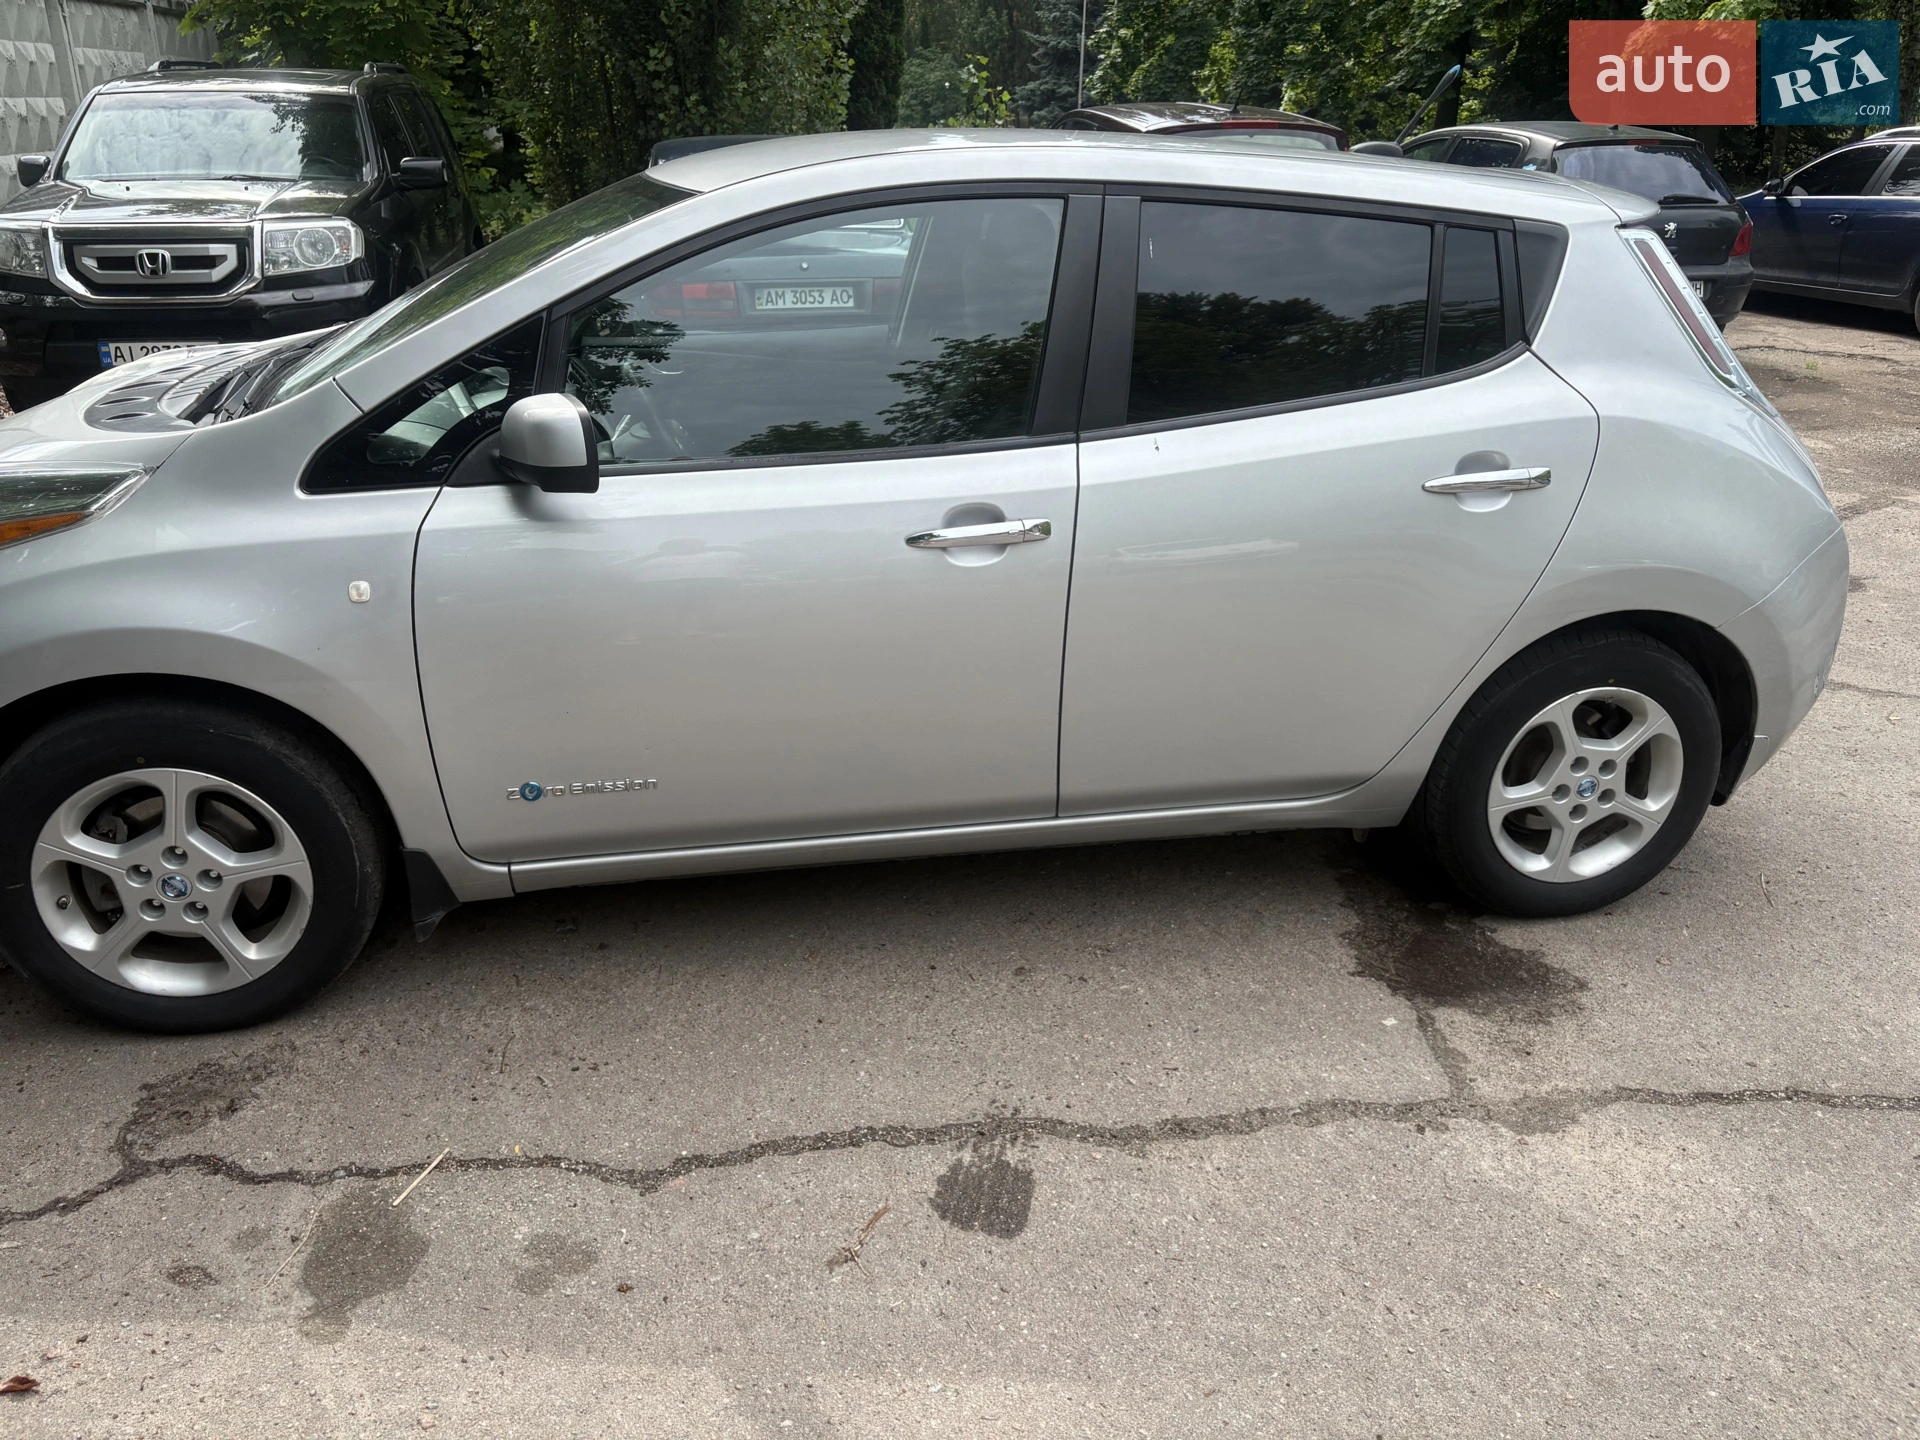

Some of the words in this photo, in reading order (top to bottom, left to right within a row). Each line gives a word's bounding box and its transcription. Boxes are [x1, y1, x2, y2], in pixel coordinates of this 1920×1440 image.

[765, 289, 786, 307] AM
[791, 288, 825, 305] 3053
[830, 288, 851, 305] AO
[114, 345, 135, 363] AI
[569, 778, 658, 794] Emission
